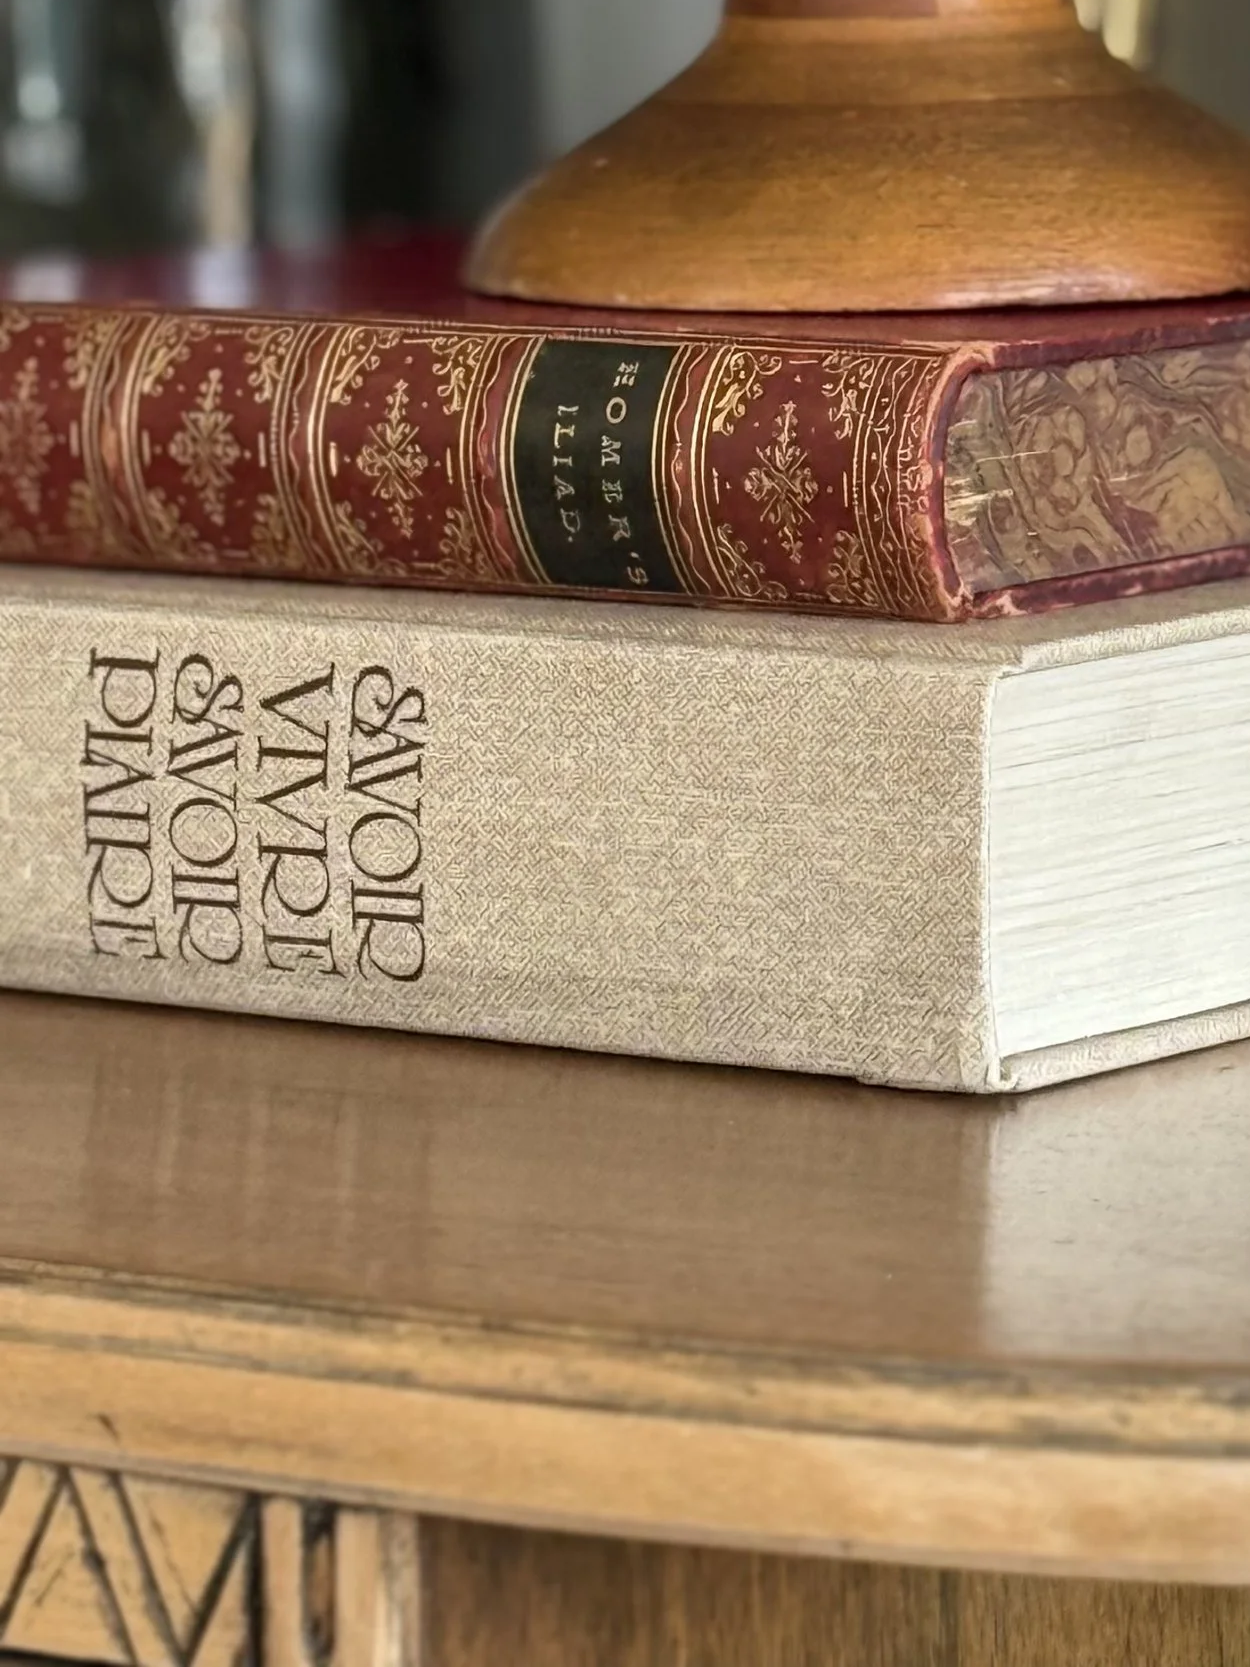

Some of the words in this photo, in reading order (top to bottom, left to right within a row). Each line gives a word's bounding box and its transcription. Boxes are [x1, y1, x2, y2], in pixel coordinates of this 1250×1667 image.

[80, 647, 167, 960] PLAIRE
[164, 652, 245, 965] SAVOIR
[255, 661, 347, 978] VIVRE
[346, 664, 427, 982] SAVOIR
